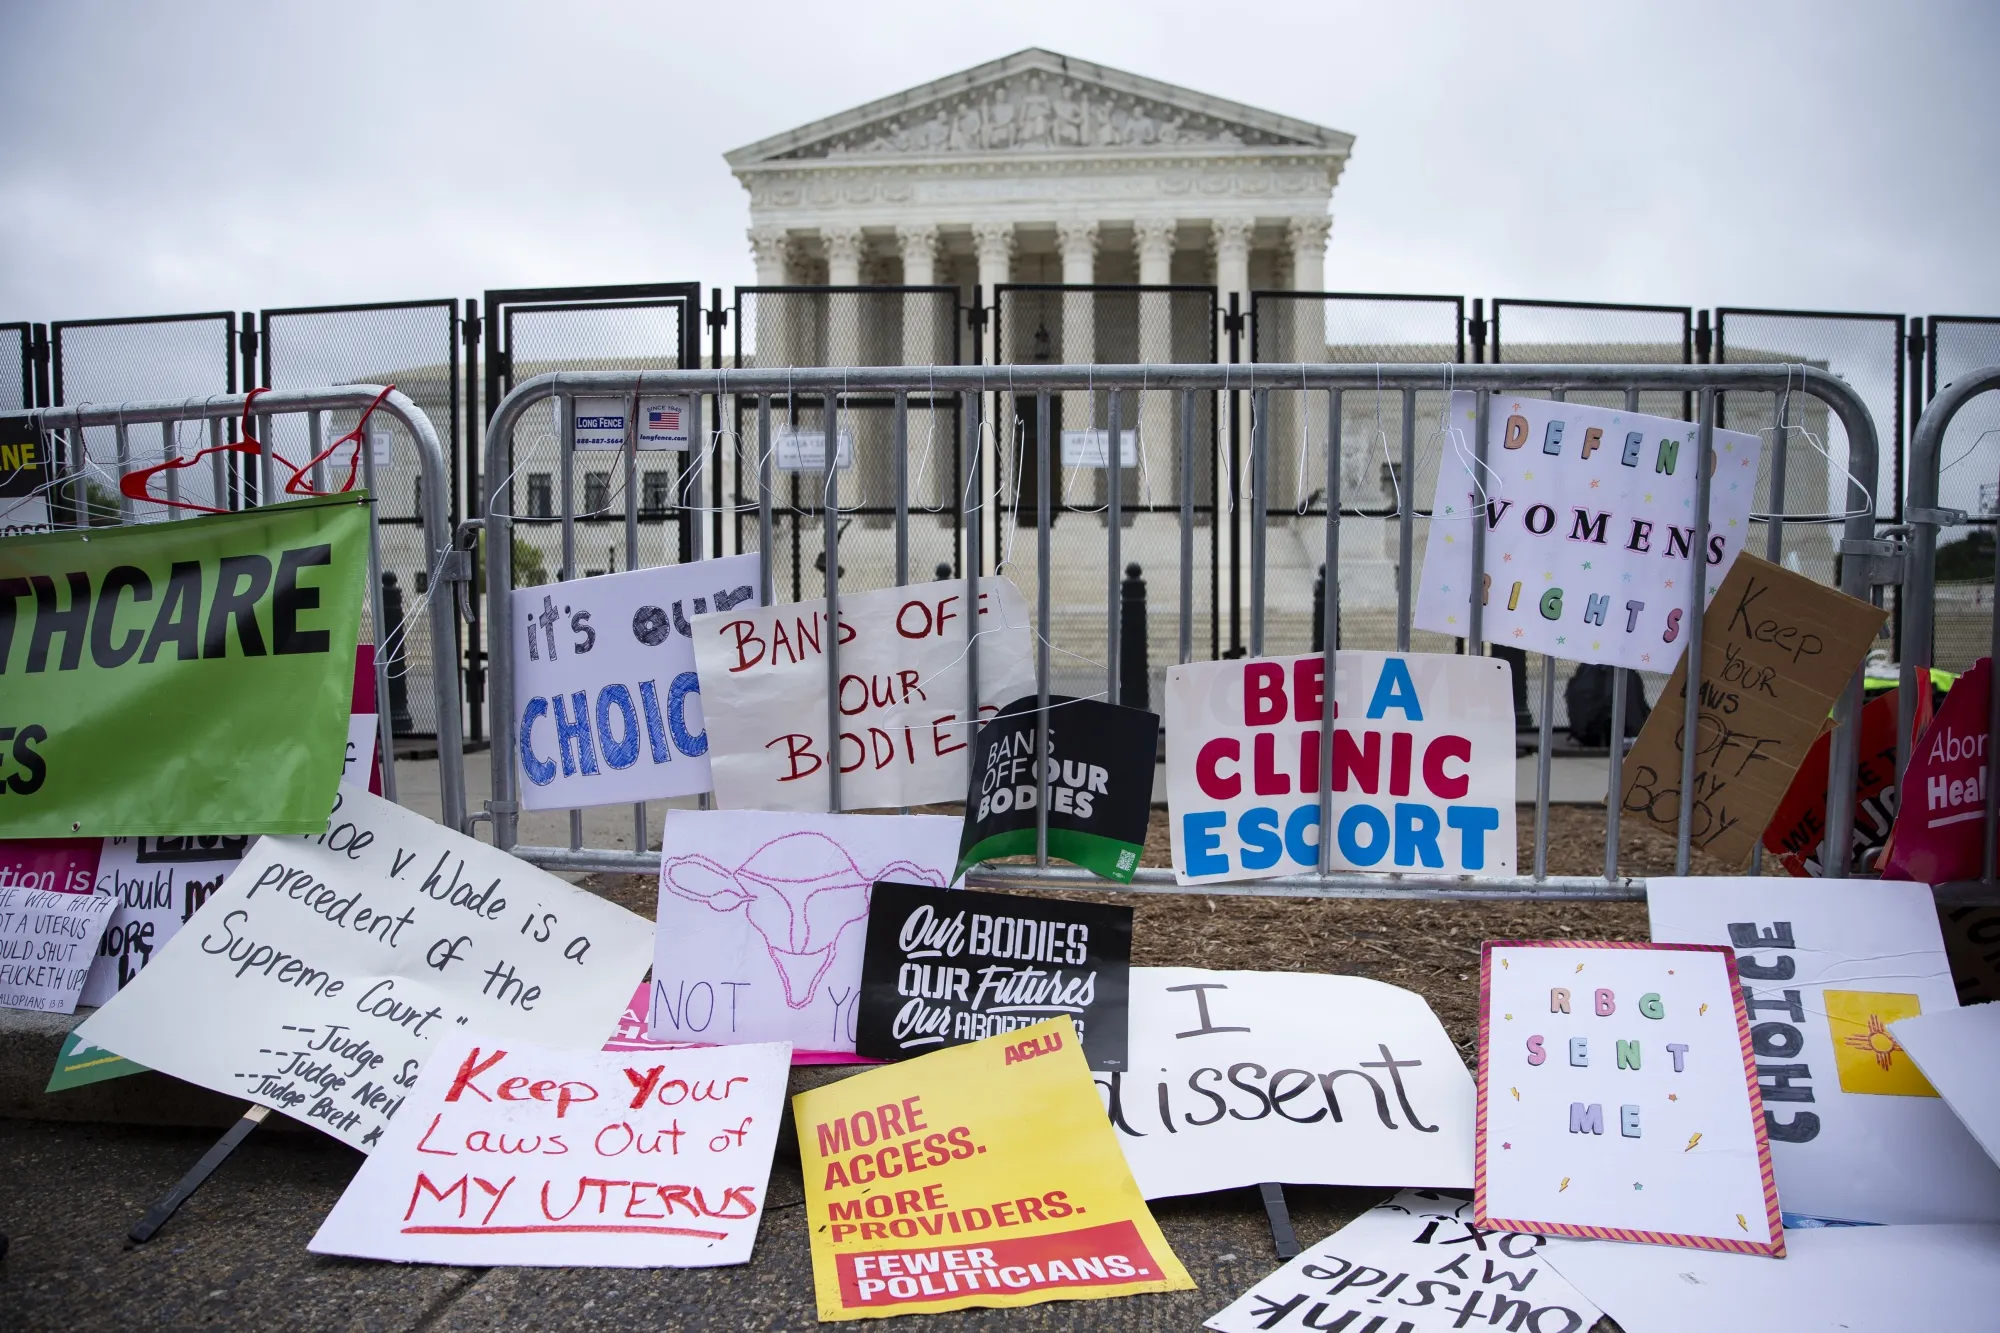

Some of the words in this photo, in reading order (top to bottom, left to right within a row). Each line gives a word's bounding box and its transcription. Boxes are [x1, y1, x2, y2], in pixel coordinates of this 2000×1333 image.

[578, 418, 598, 428] LONG
[599, 417, 623, 428] FENCE
[647, 405, 667, 413] SINCE
[640, 434, 688, 442] longfence.com
[527, 595, 596, 662] it's
[1728, 577, 1823, 664] Keep
[838, 669, 927, 716] OUR
[1244, 658, 1339, 727] BE
[1365, 658, 1424, 721] A
[1719, 643, 1778, 698] YOUR
[1196, 729, 1472, 800] CLINIC
[1674, 712, 1781, 778] OFF
[982, 757, 1028, 796] OFF
[1032, 757, 1109, 796] OUR
[1183, 802, 1499, 878] ESCORT
[1781, 808, 1824, 853] WE
[65, 862, 92, 891] is
[24, 891, 62, 909] WHO
[67, 895, 113, 913] HATH
[420, 850, 506, 920] Wade
[520, 903, 557, 943] is
[564, 935, 591, 965] a
[15, 914, 28, 934] A
[35, 915, 90, 940] UTERUS
[246, 863, 414, 948] precedent
[426, 936, 473, 971] of
[483, 960, 542, 1011] the
[898, 904, 966, 958] Our
[969, 914, 1089, 965] BODIES
[37, 941, 77, 962] SHUT
[201, 910, 345, 998] Supreme
[0, 964, 66, 990] FUCKETH
[898, 962, 970, 1002] OUR
[971, 964, 1097, 1012] Futures
[653, 979, 751, 1032] NOT
[892, 997, 952, 1040] Our
[1165, 983, 1251, 1039] I
[1550, 987, 1665, 1020] RBG
[1004, 1031, 1063, 1067] ACLU
[1526, 1034, 1690, 1073] SENT
[1727, 921, 1820, 1144] CHOICE
[351, 1081, 406, 1121] Neil
[444, 1047, 600, 1118] Keep
[623, 1065, 749, 1110] Your
[307, 1096, 362, 1132] Brett
[416, 1113, 570, 1157] Laws
[595, 1118, 688, 1157] Out
[708, 1116, 754, 1153] of
[816, 1095, 928, 1158] MORE
[1569, 1102, 1642, 1139] ME
[823, 1125, 988, 1191] ACCESS.
[403, 1170, 516, 1226] MY
[540, 1175, 758, 1222] UTERUS
[828, 1183, 949, 1222] MORE
[831, 1190, 1087, 1243] PROVIDERS.
[853, 1247, 999, 1278] FEWER
[858, 1254, 1150, 1301] POLITICIANS.
[1434, 1253, 1538, 1292] MY
